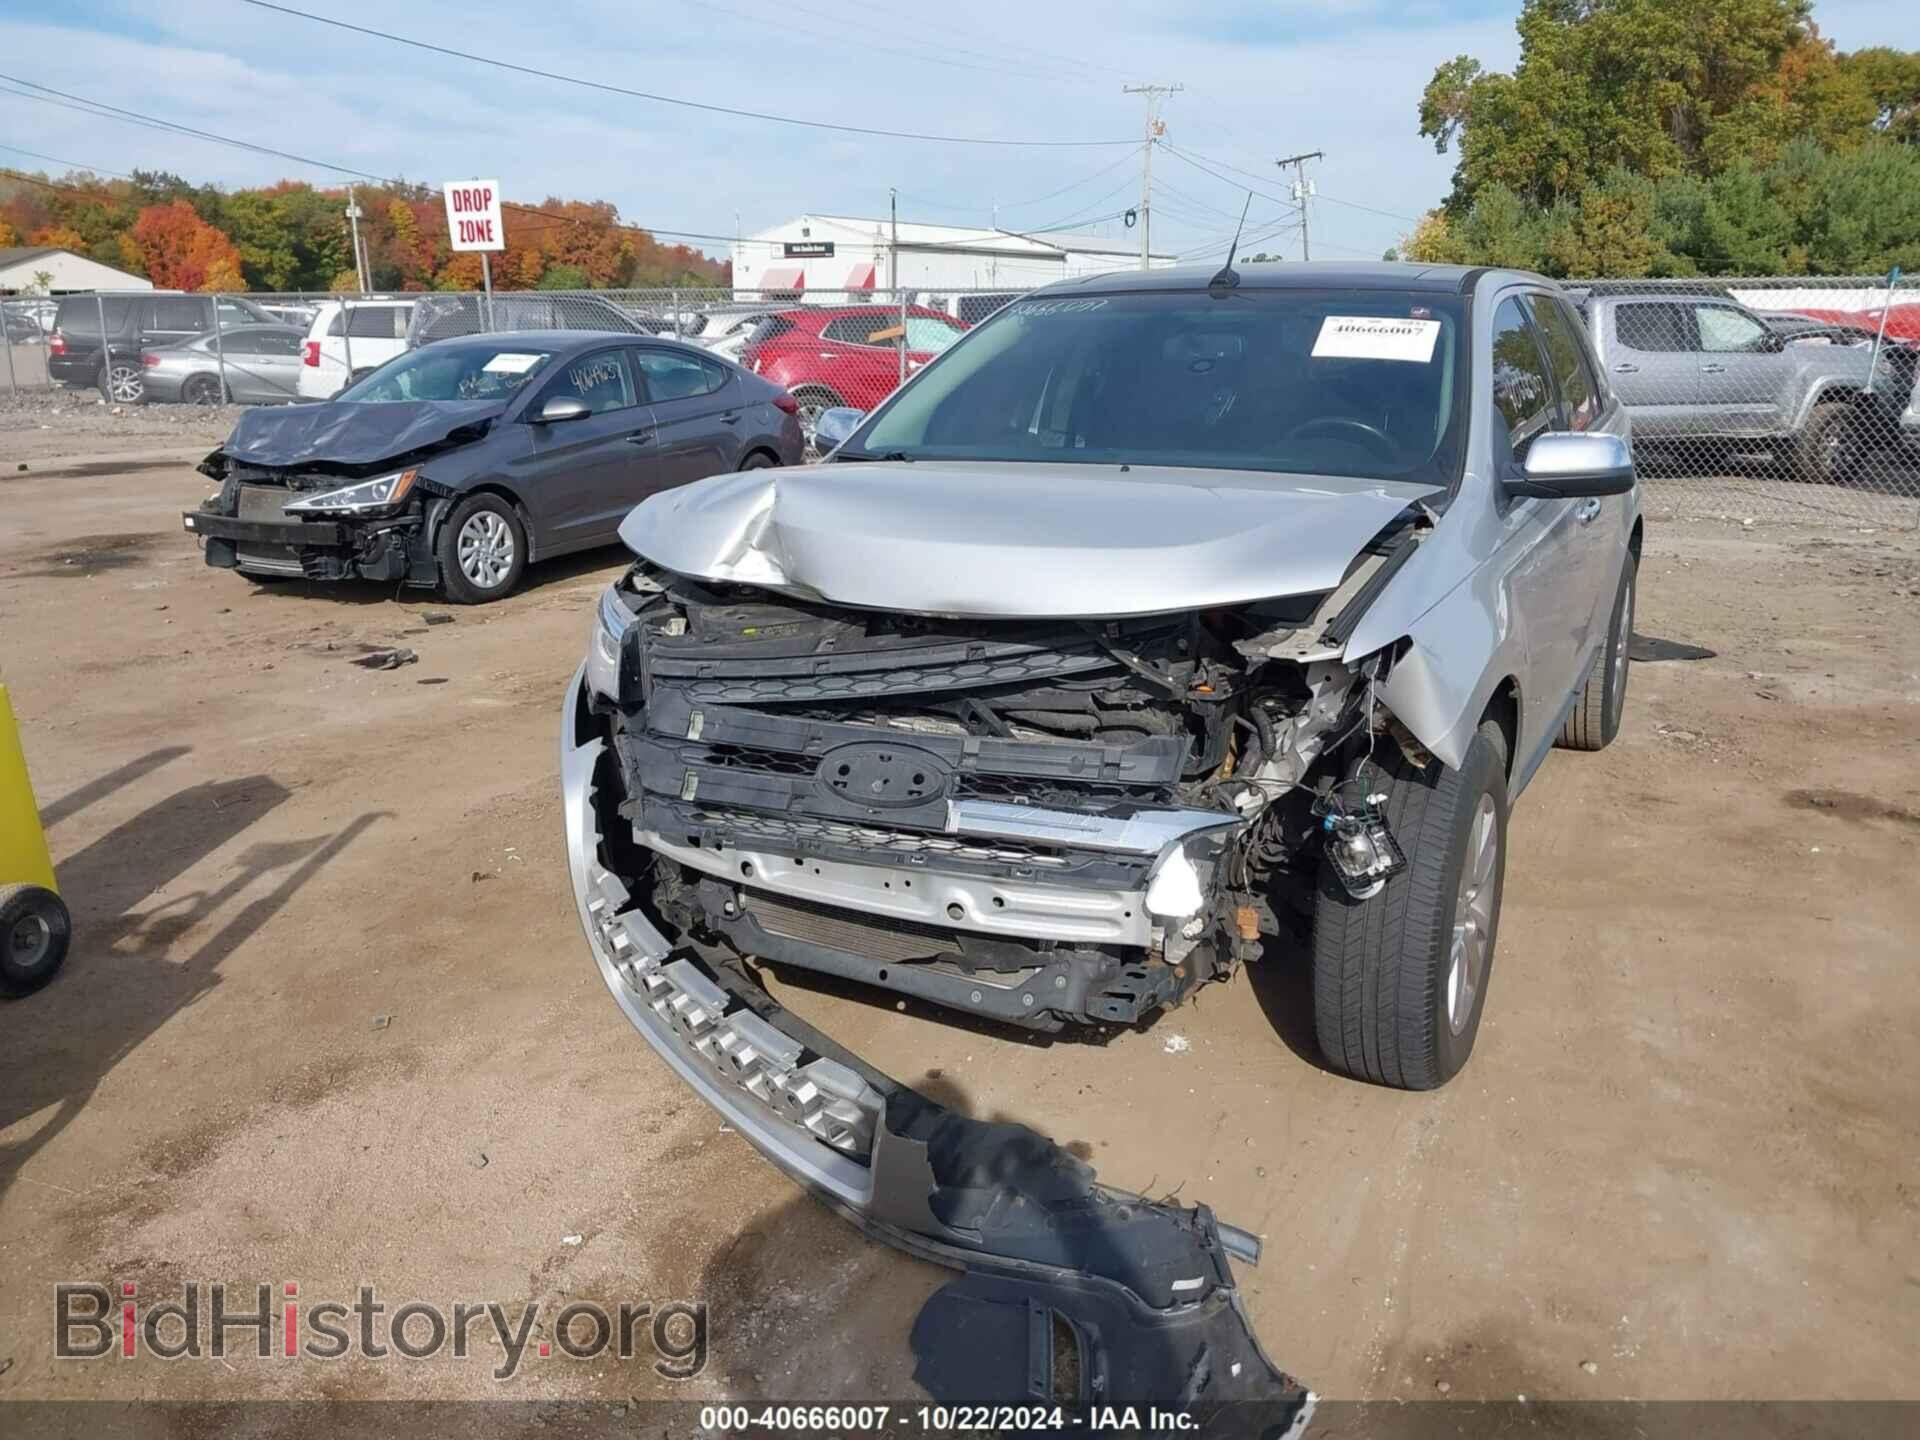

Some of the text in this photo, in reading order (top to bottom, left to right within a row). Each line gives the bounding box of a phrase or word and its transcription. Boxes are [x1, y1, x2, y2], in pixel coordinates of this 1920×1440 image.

[451, 188, 492, 212] DROP
[458, 219, 494, 243] ZONE
[1333, 325, 1424, 335] 40666007
